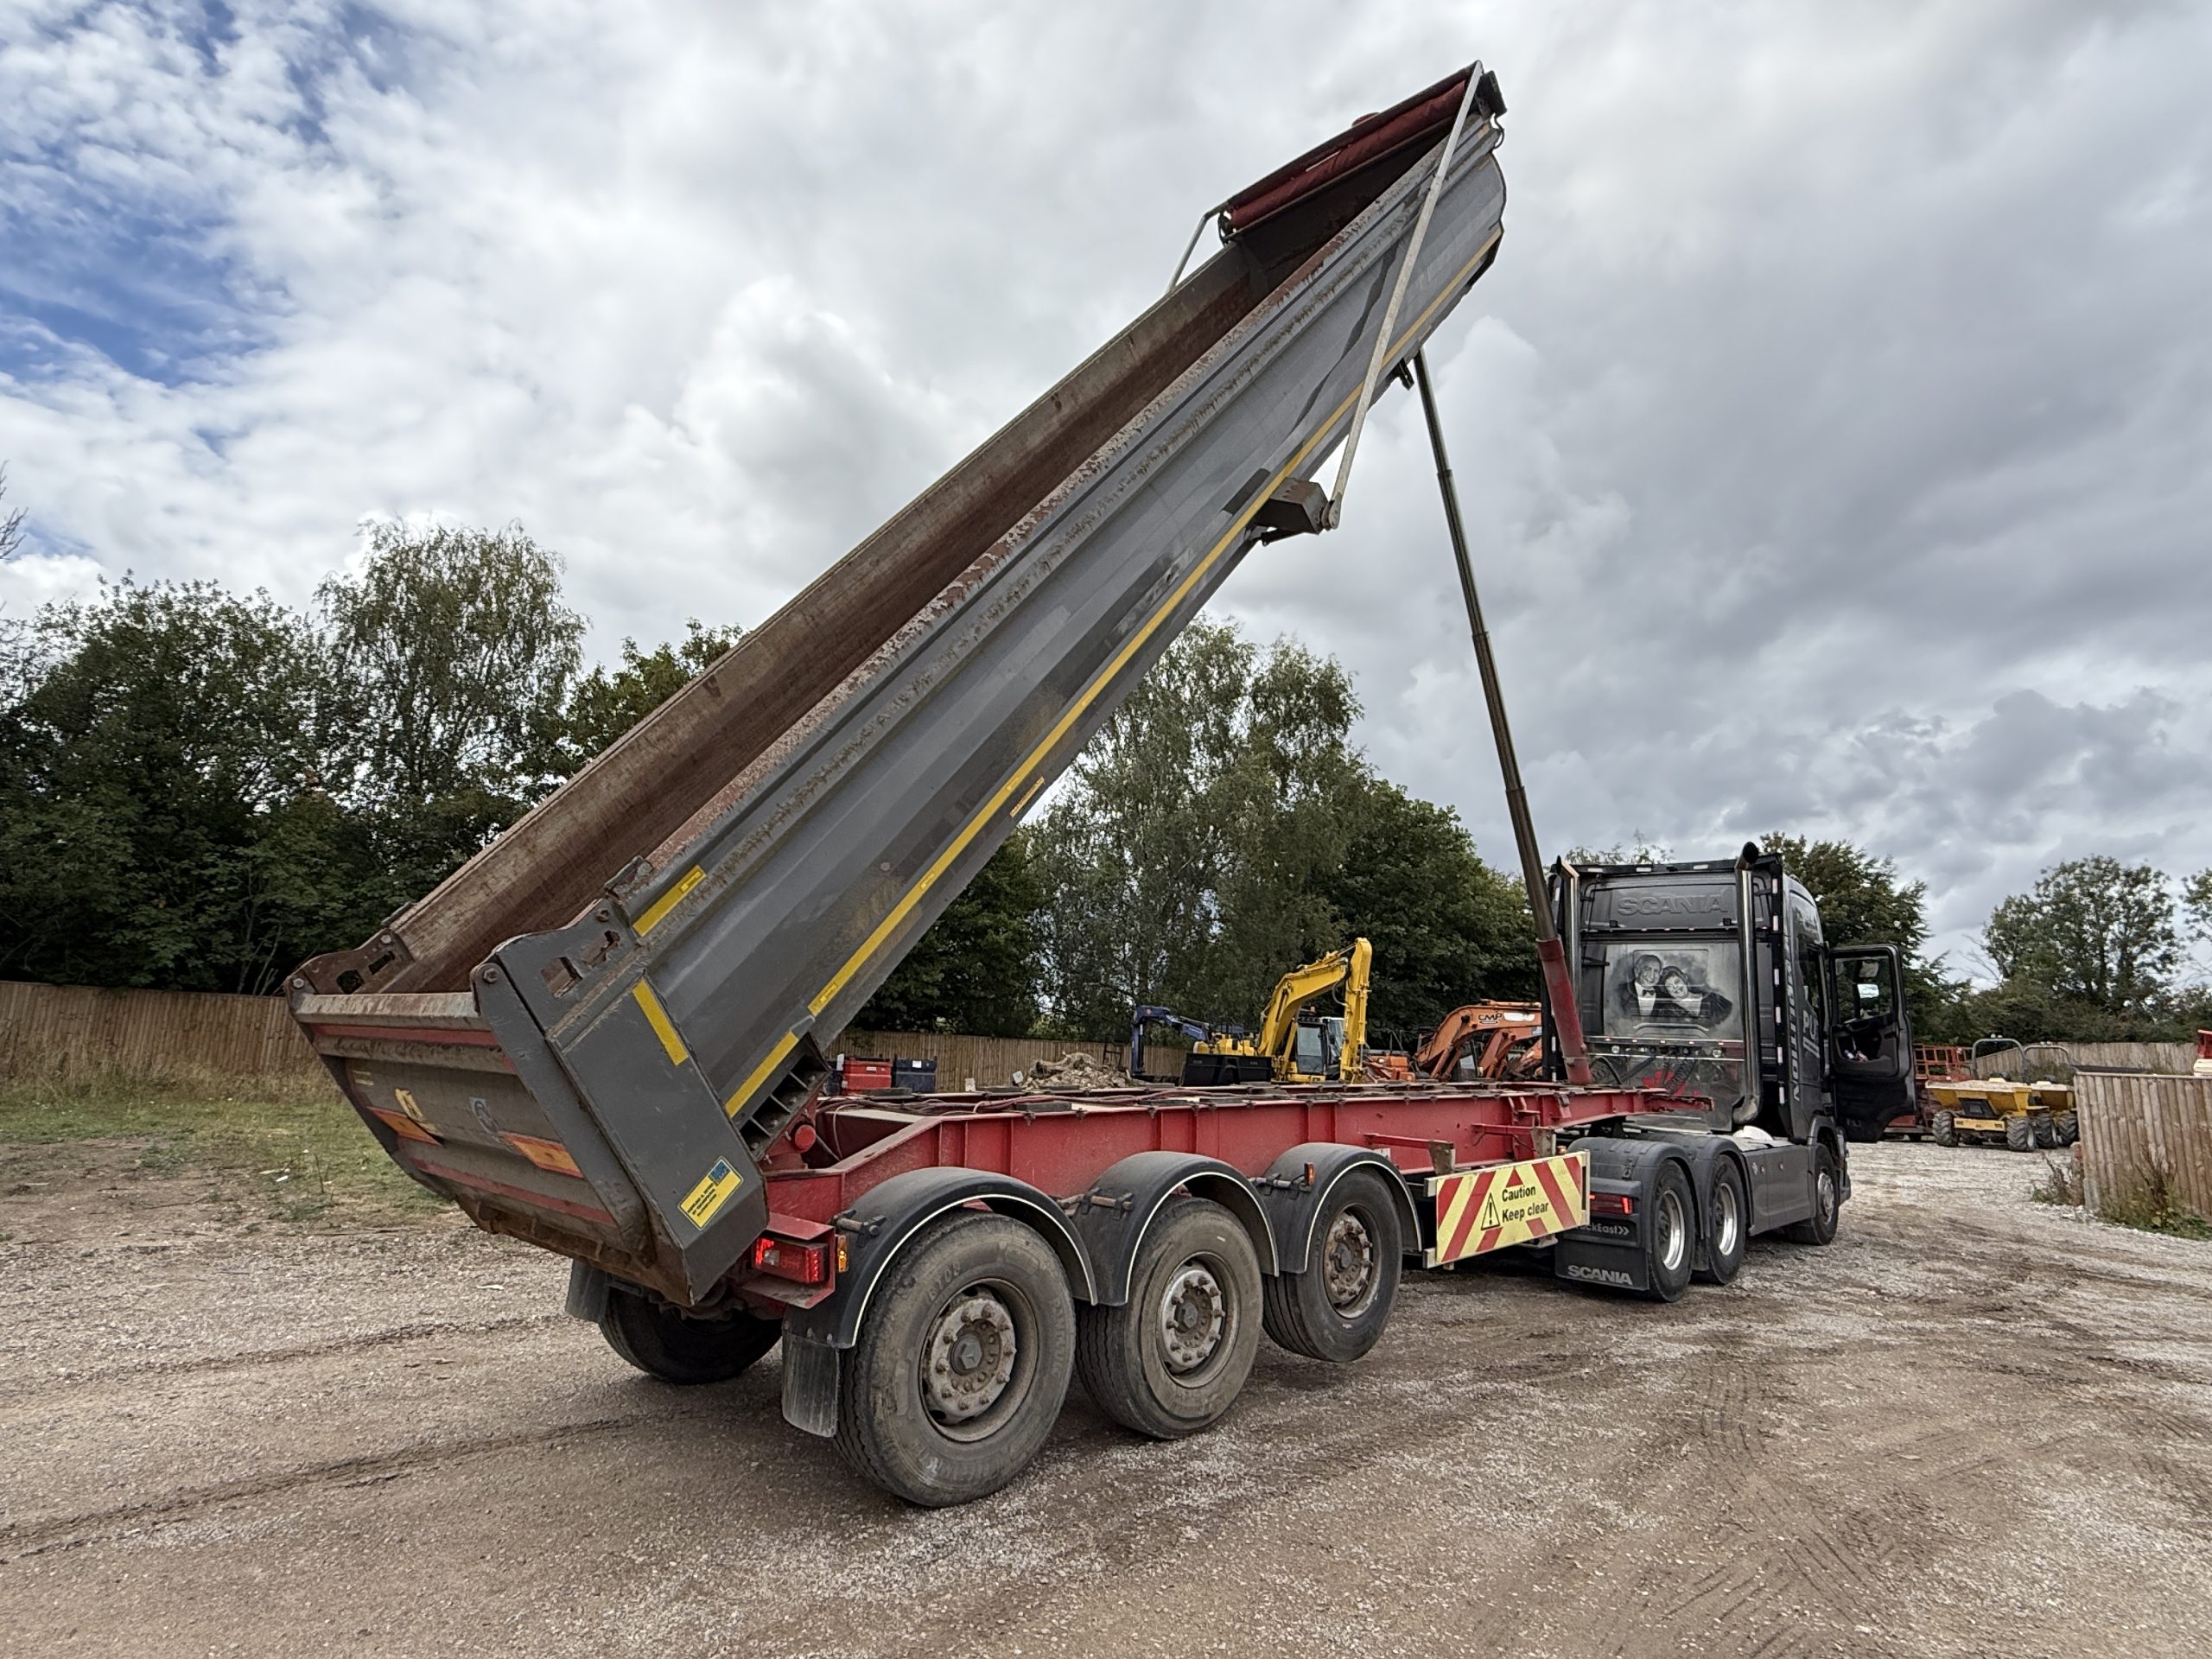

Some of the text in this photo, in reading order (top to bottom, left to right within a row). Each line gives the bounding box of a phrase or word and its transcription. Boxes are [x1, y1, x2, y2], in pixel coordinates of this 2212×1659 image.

[1617, 895, 1728, 916] SCANIA
[1783, 925, 1800, 1102] MOLITION
[1502, 1185, 1536, 1202] Caution
[1502, 1202, 1549, 1223] Keep clear
[1576, 1223, 1618, 1235] uckEast
[1567, 1265, 1633, 1286] SCANIA
